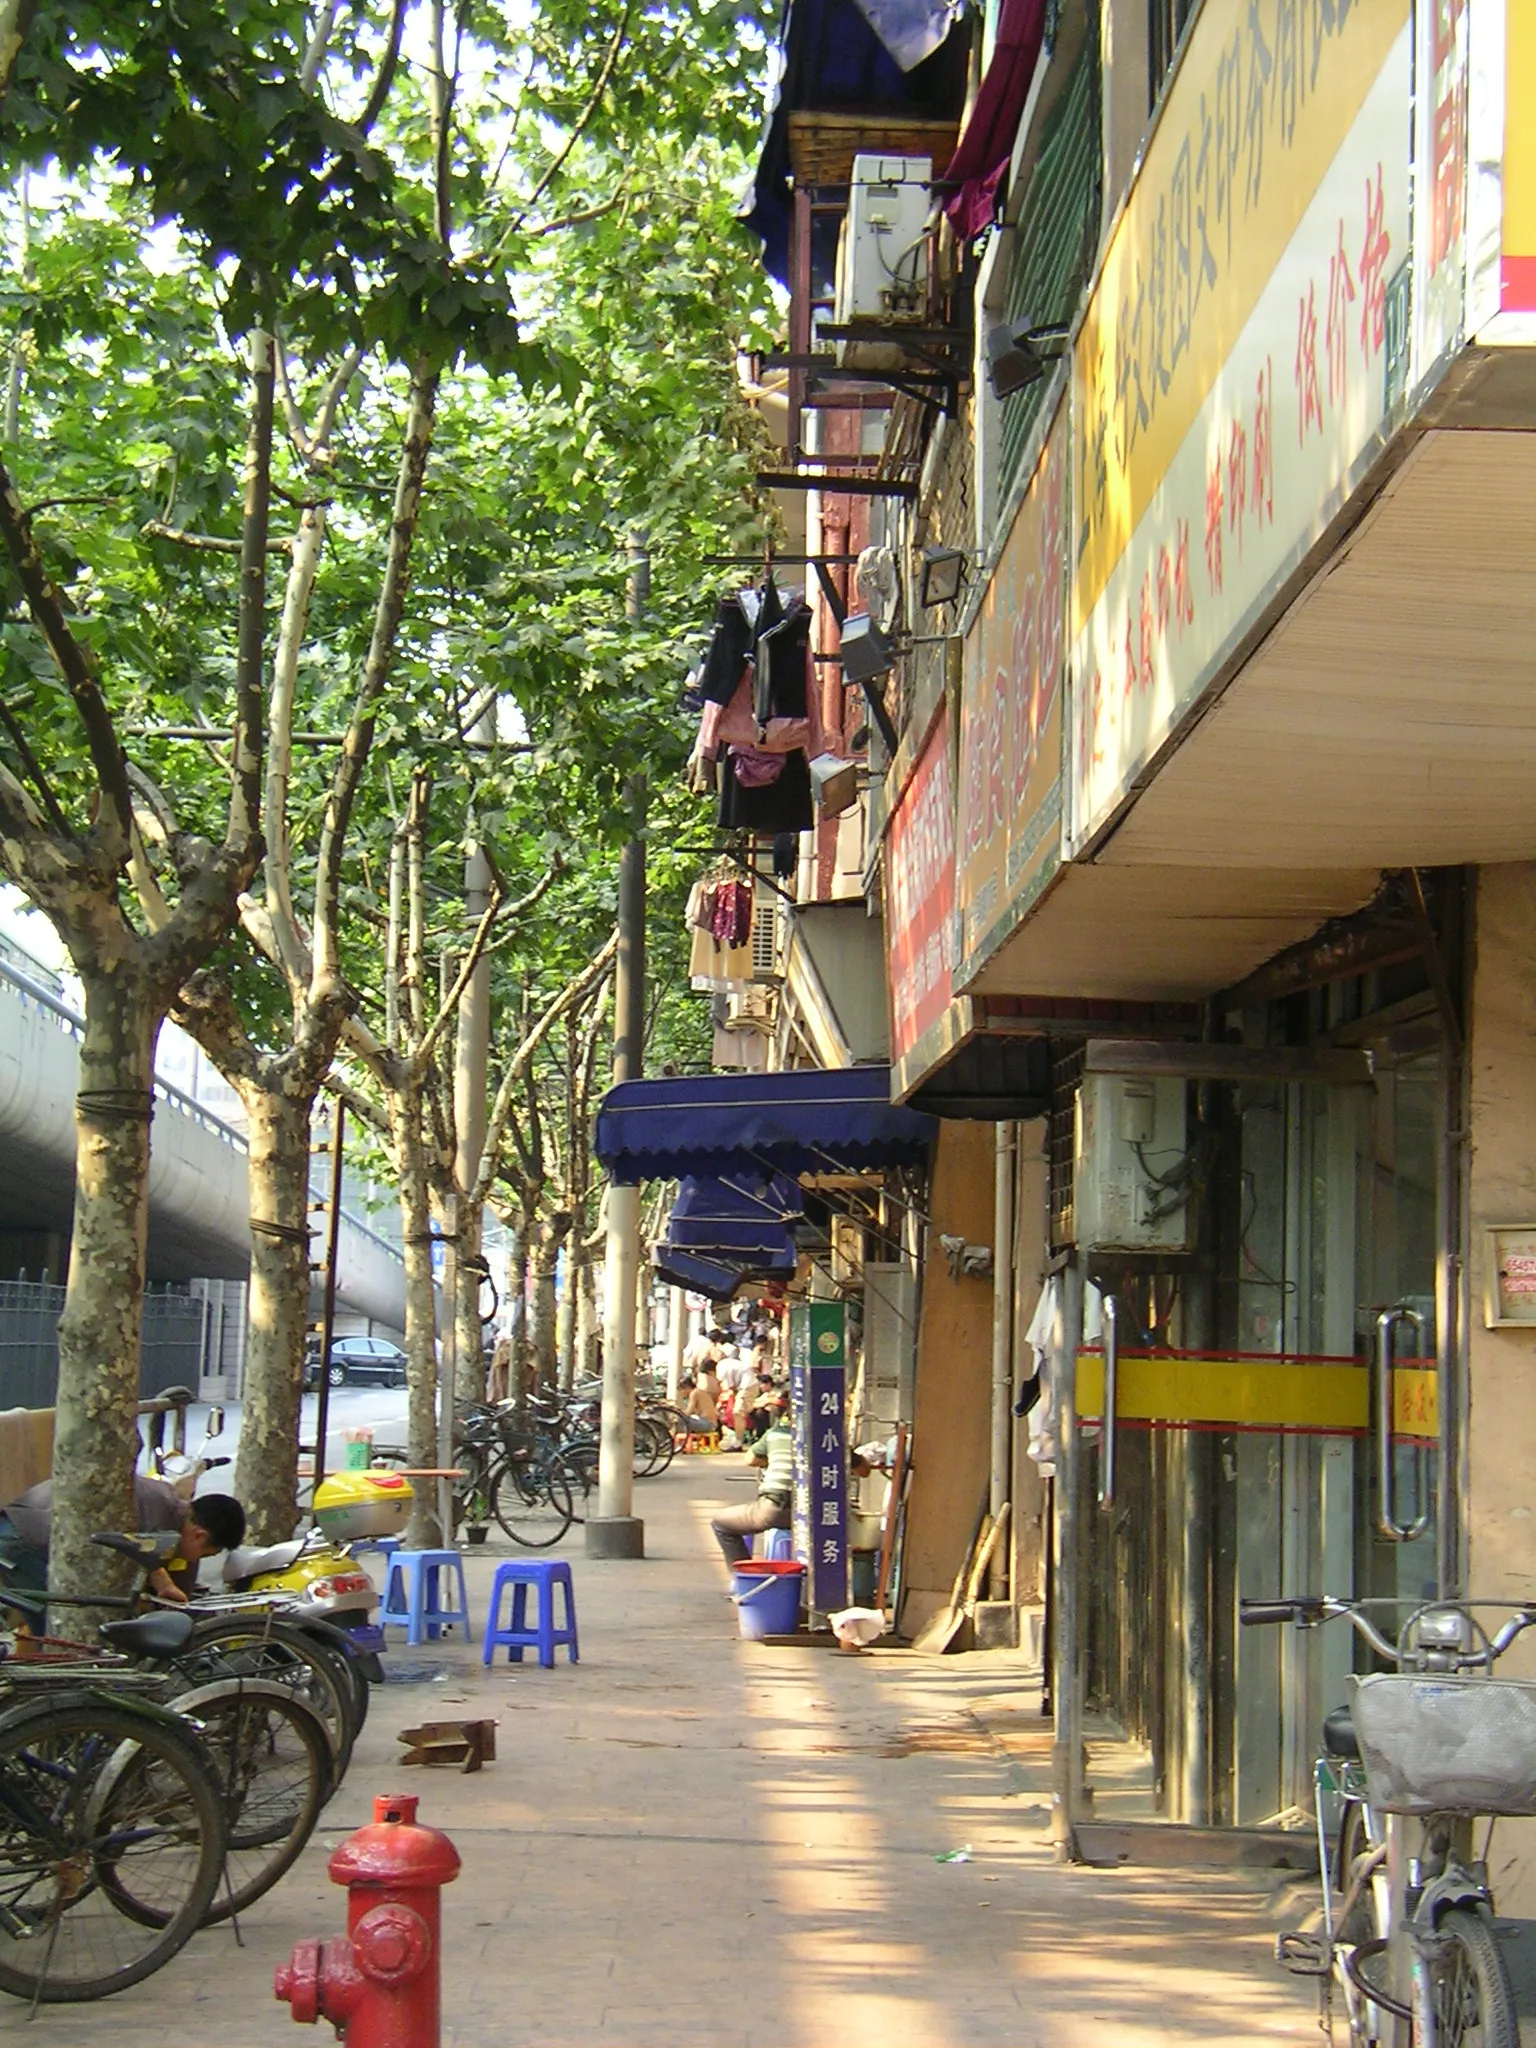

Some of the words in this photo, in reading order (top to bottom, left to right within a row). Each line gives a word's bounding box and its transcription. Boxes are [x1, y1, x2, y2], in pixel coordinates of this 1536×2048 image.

[1204, 354, 1274, 597] 精印刷
[1295, 162, 1390, 450] 低价格
